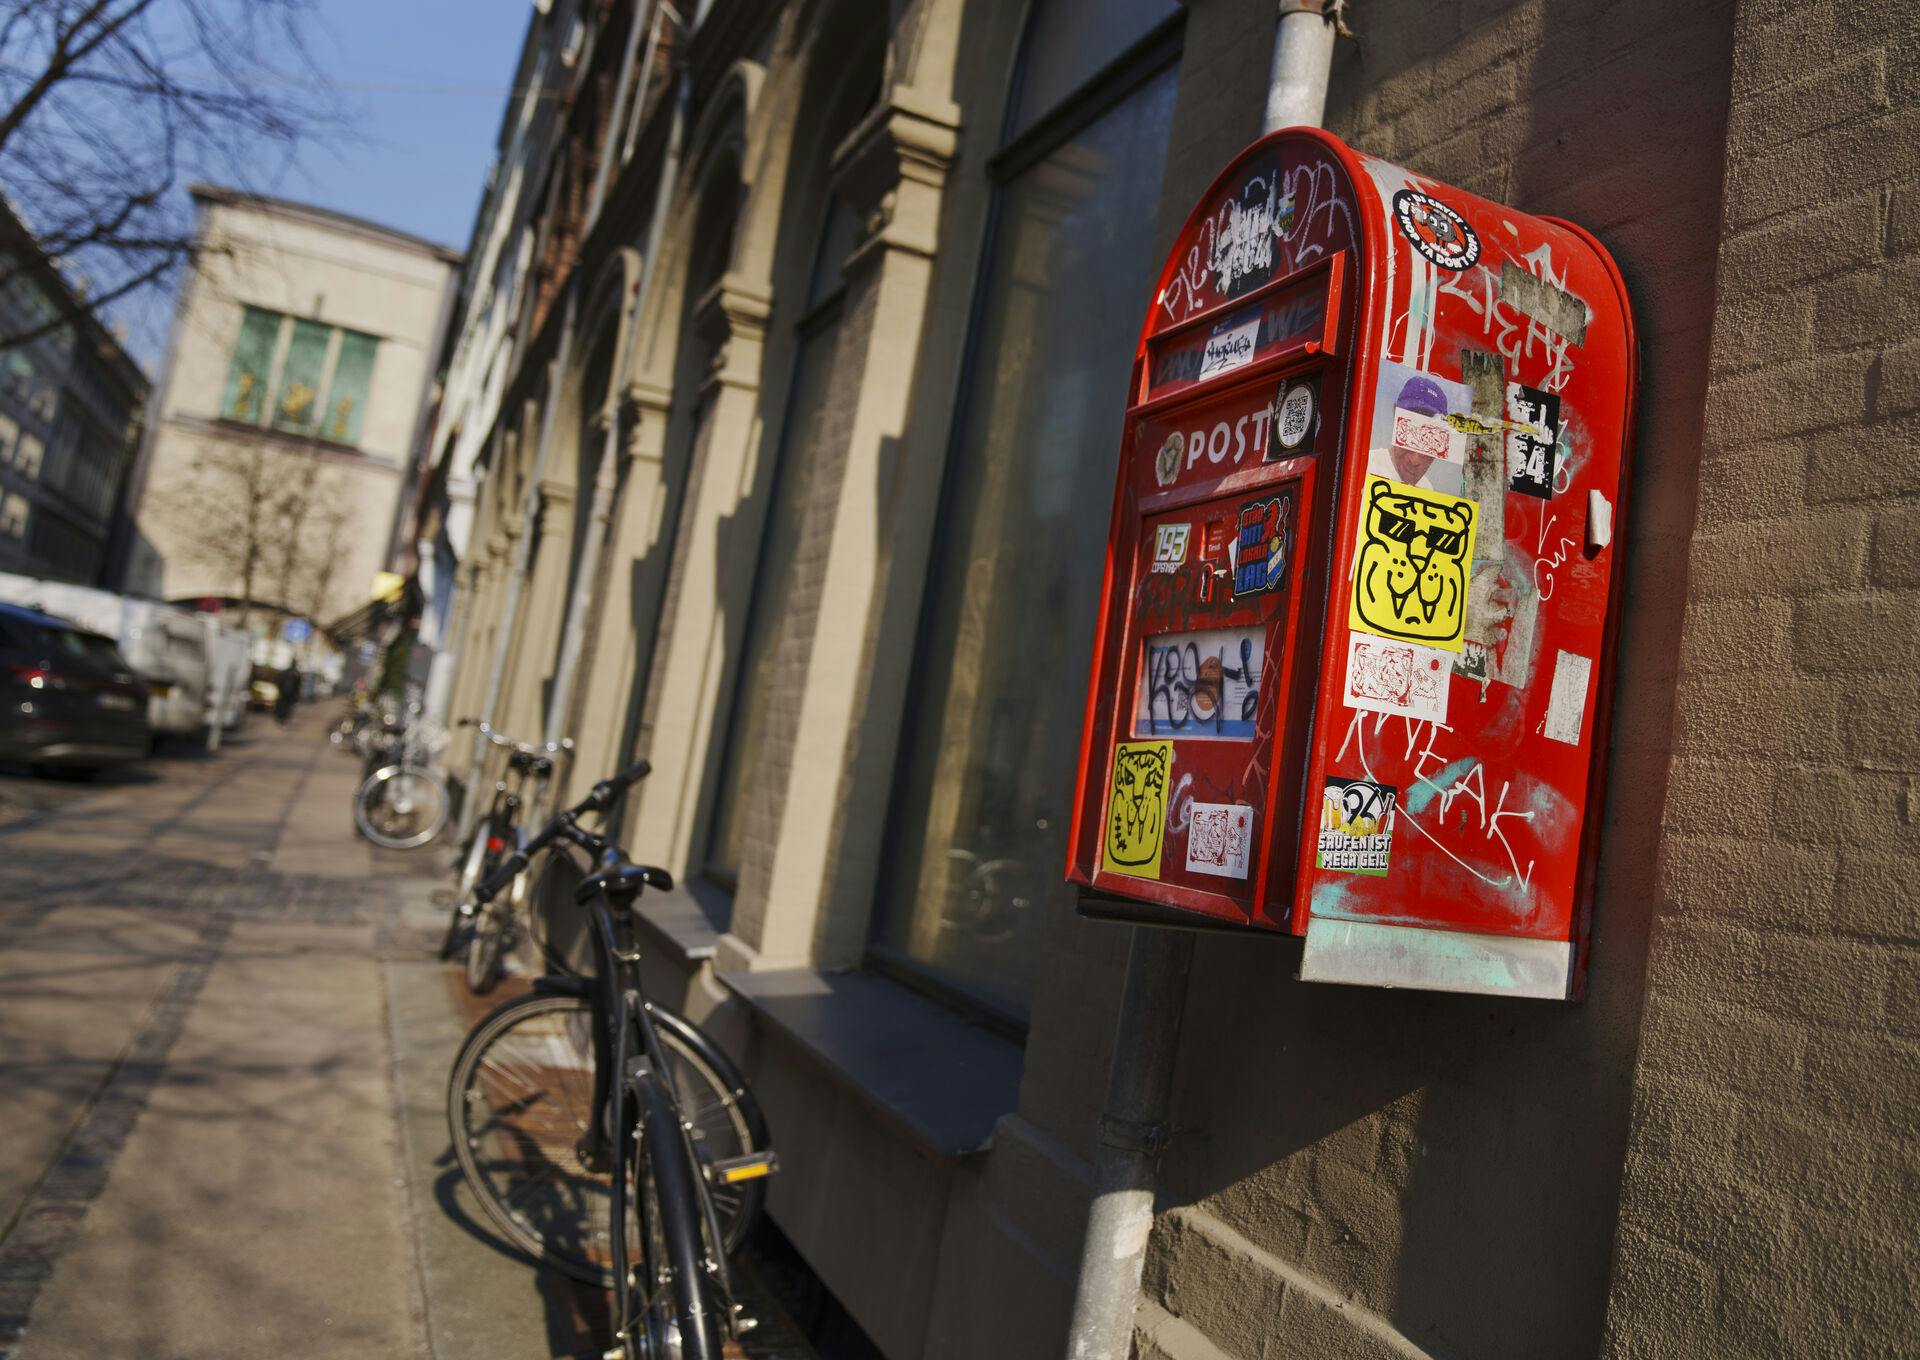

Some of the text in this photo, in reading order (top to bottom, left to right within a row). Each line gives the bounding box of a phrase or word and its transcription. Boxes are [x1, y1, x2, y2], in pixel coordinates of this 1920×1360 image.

[1401, 215, 1420, 241] HOP
[1420, 241, 1434, 258] YA
[1186, 408, 1270, 470] POST
[1155, 526, 1189, 561] 193
[1318, 834, 1392, 852] SAUFEN IST
[1322, 851, 1388, 869] MEGA GEIL
